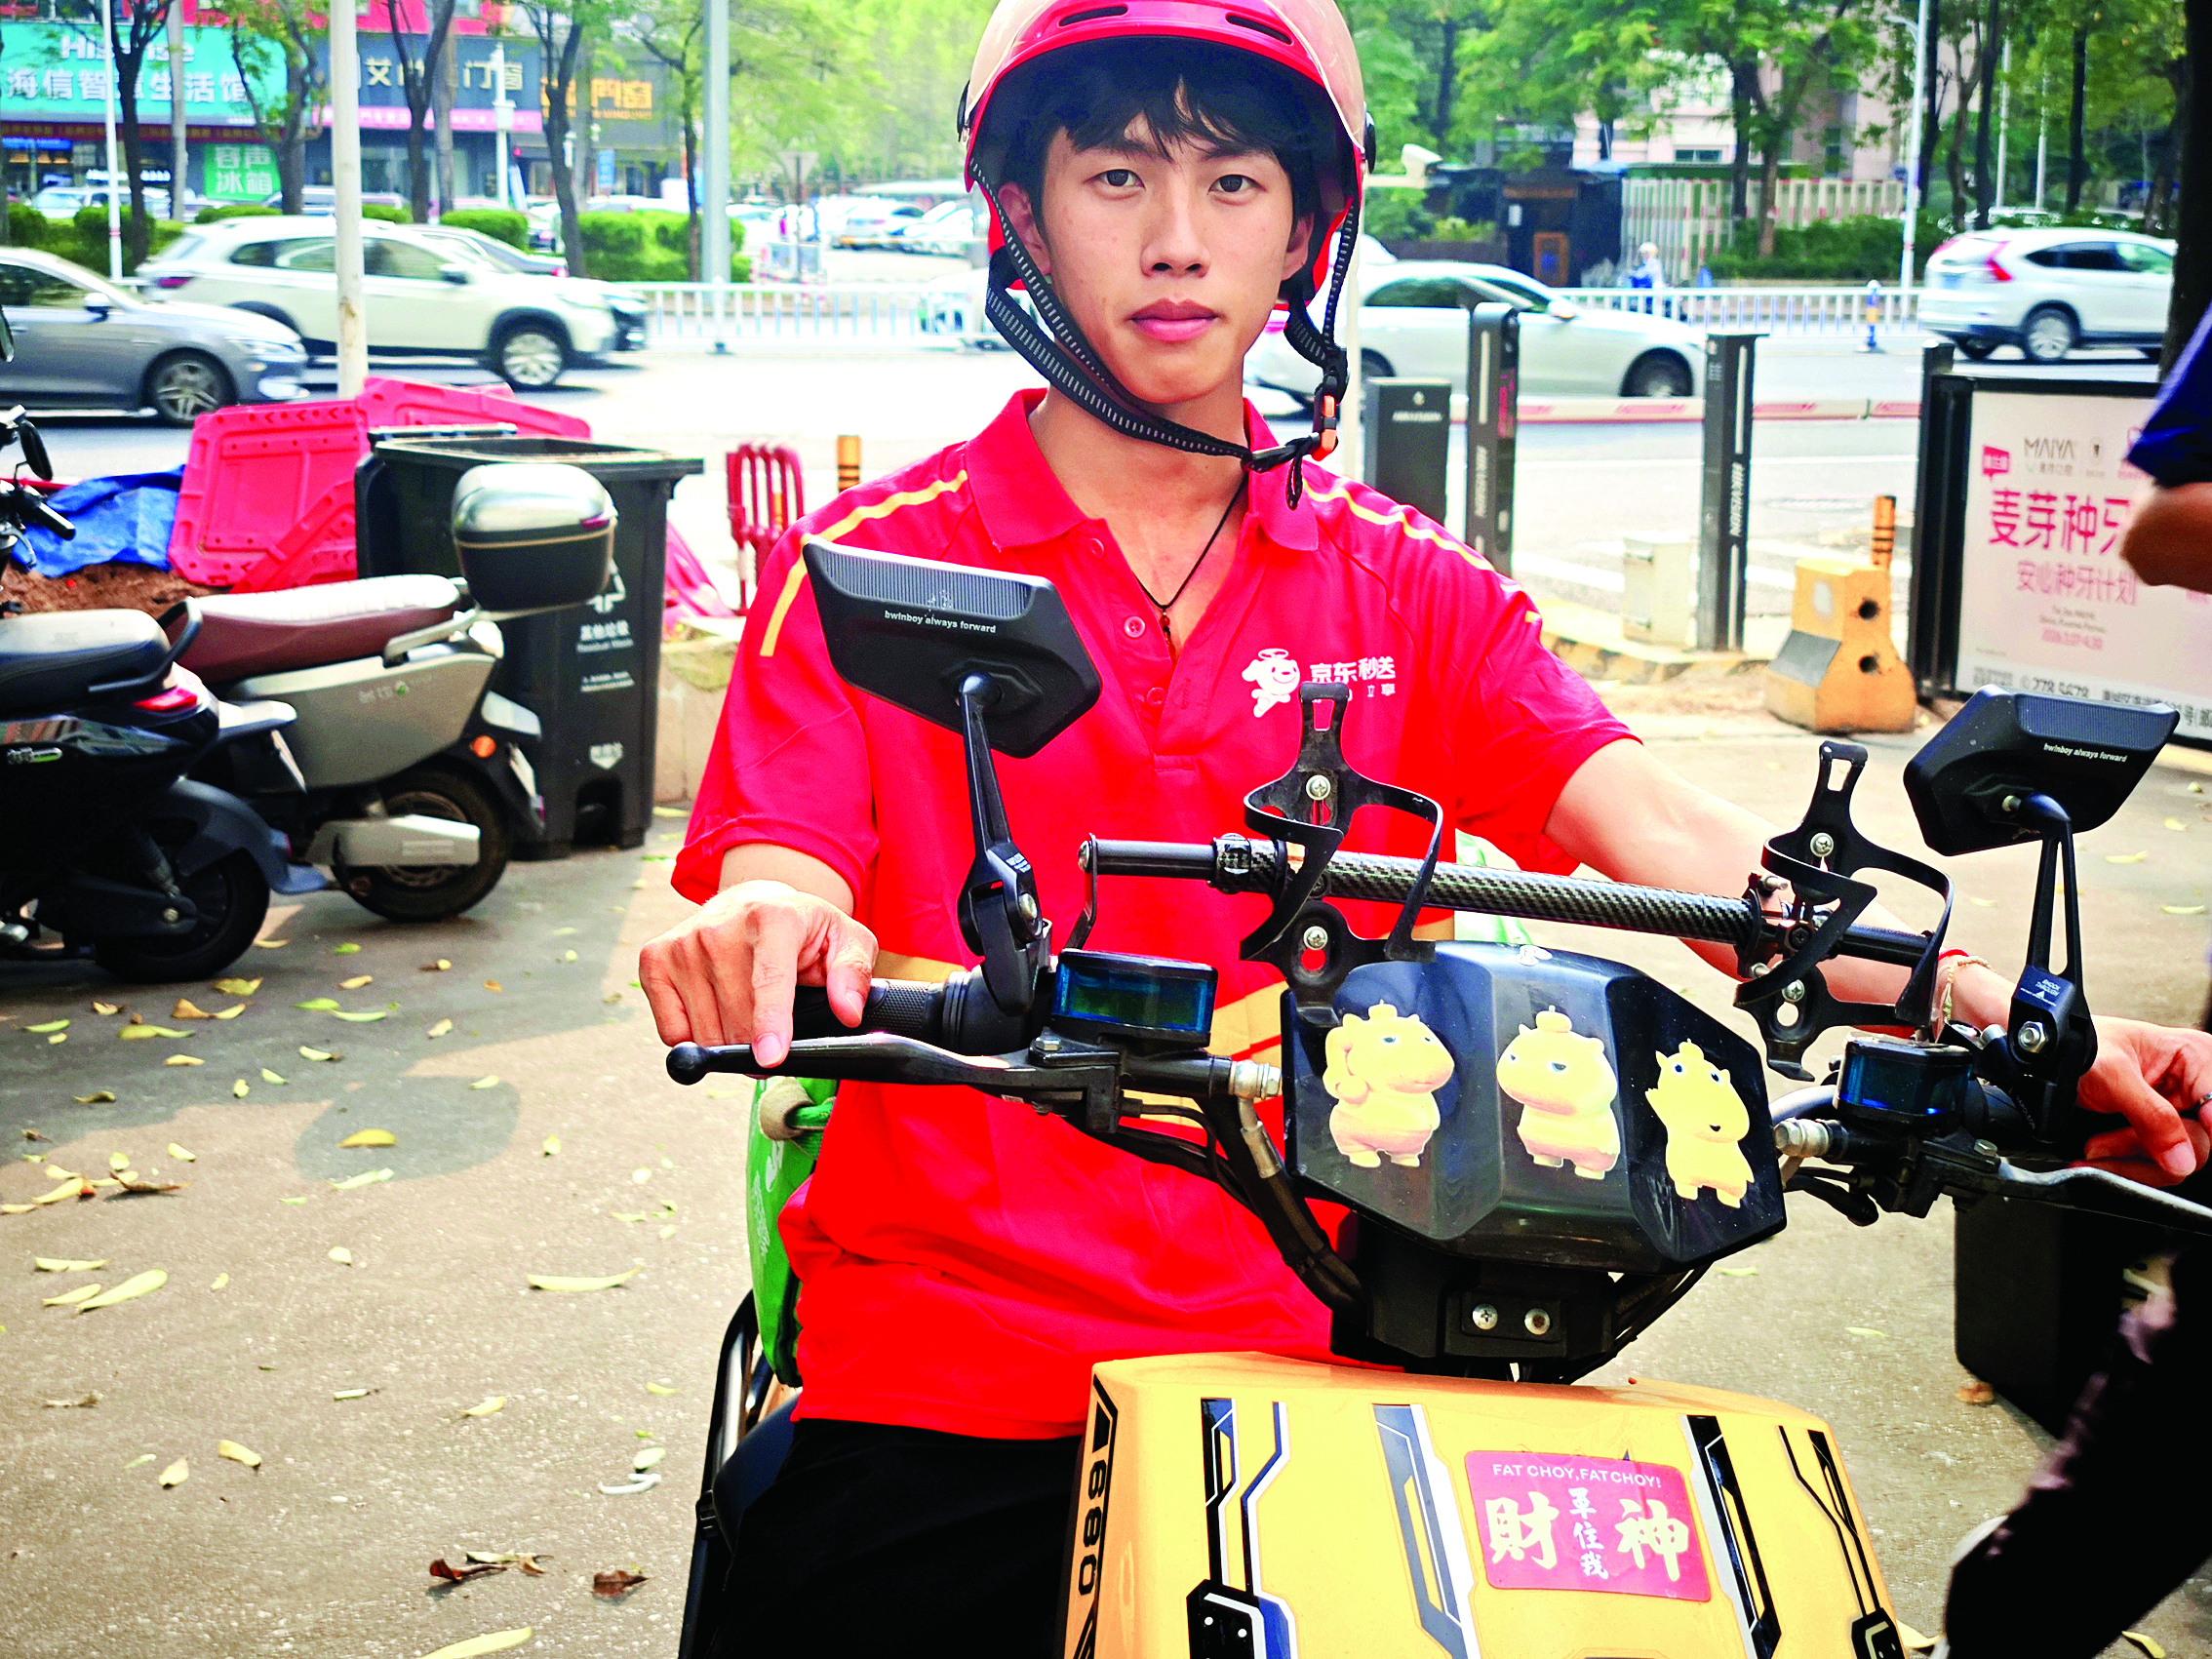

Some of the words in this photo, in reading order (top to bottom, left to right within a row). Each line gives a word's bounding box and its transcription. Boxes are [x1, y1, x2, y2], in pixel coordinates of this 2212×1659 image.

[2024, 437, 2074, 460] MAIYA
[885, 611, 923, 624] bwinboy
[926, 615, 958, 629] always
[960, 620, 997, 633] forward
[1310, 656, 1396, 684] 京东秒送
[2074, 748, 2099, 759] always
[2100, 752, 2127, 762] forward
[1492, 1464, 1522, 1477] FAT
[1610, 1471, 1661, 1488] CHOY!
